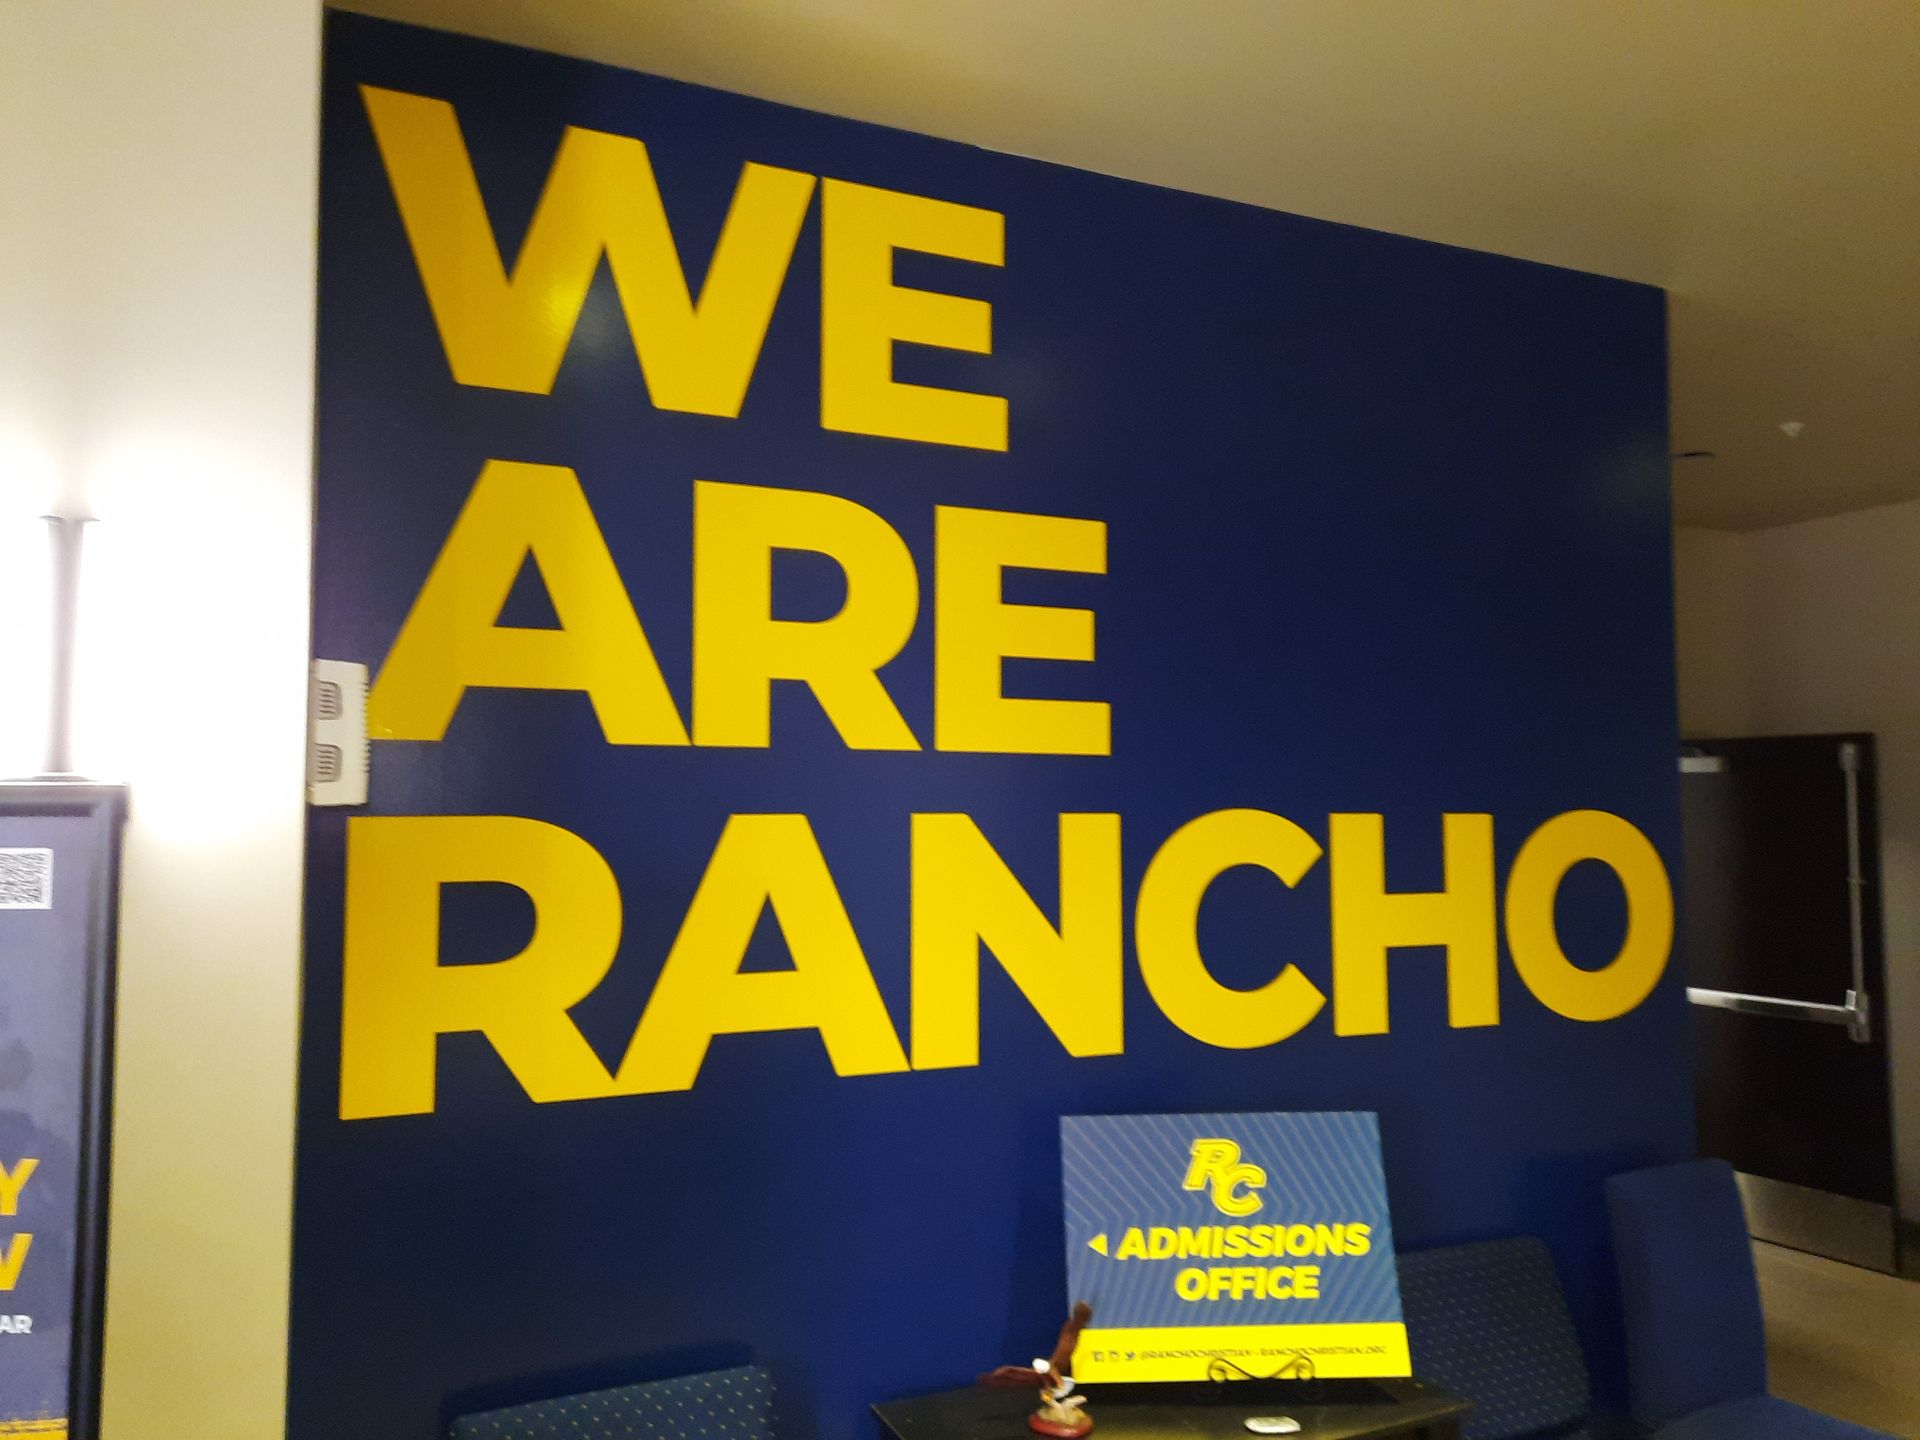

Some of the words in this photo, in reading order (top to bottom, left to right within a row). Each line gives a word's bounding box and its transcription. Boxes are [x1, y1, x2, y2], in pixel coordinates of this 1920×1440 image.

[360, 84, 1009, 453] WE
[367, 459, 1112, 756] ARE
[338, 808, 1674, 1121] RANCHO
[1115, 1222, 1372, 1261] ADMISSIONS
[1182, 1137, 1268, 1217] RC
[1174, 1264, 1321, 1302] OFFICE
